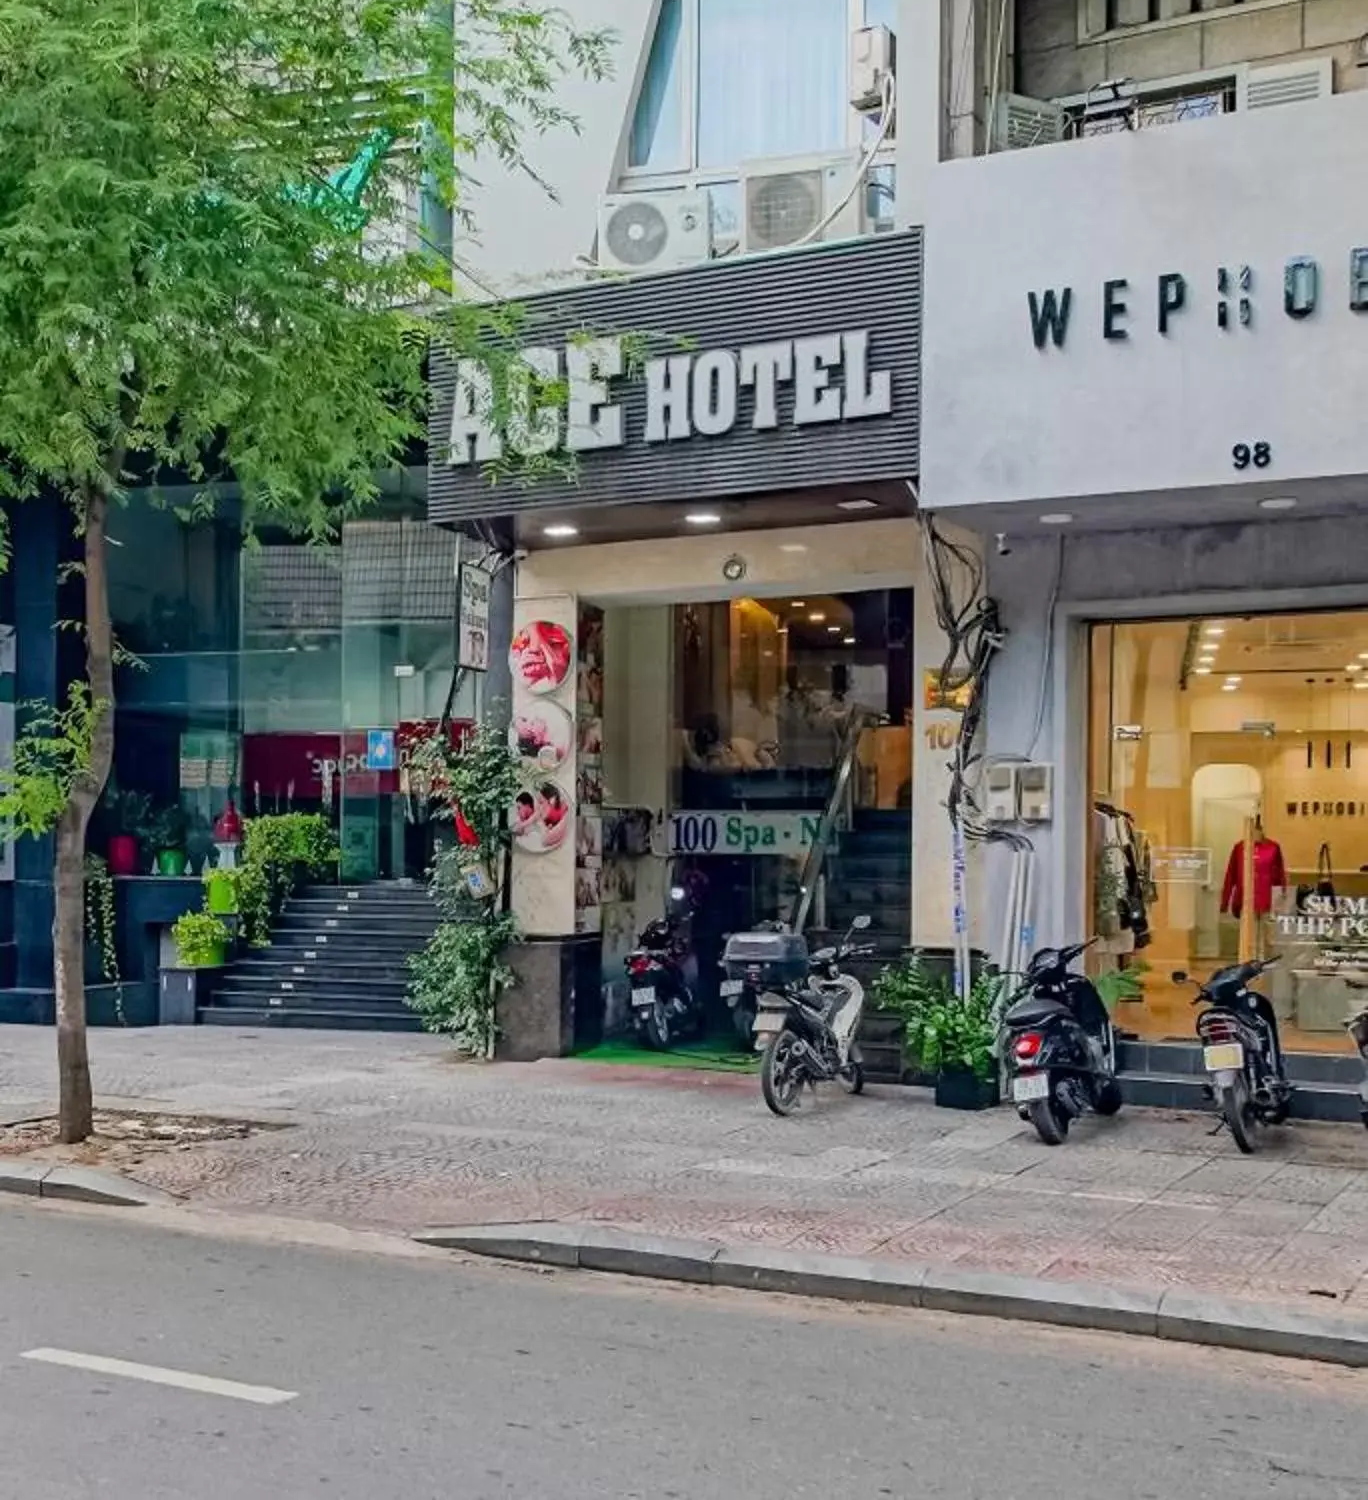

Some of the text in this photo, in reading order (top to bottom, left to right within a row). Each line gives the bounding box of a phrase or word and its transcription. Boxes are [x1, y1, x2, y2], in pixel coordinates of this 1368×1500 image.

[645, 329, 892, 443] HOTEL
[1232, 440, 1272, 470] 98
[925, 722, 958, 750] 10
[672, 815, 718, 852] 100
[725, 816, 776, 852] Spa
[1277, 915, 1335, 935] THE
